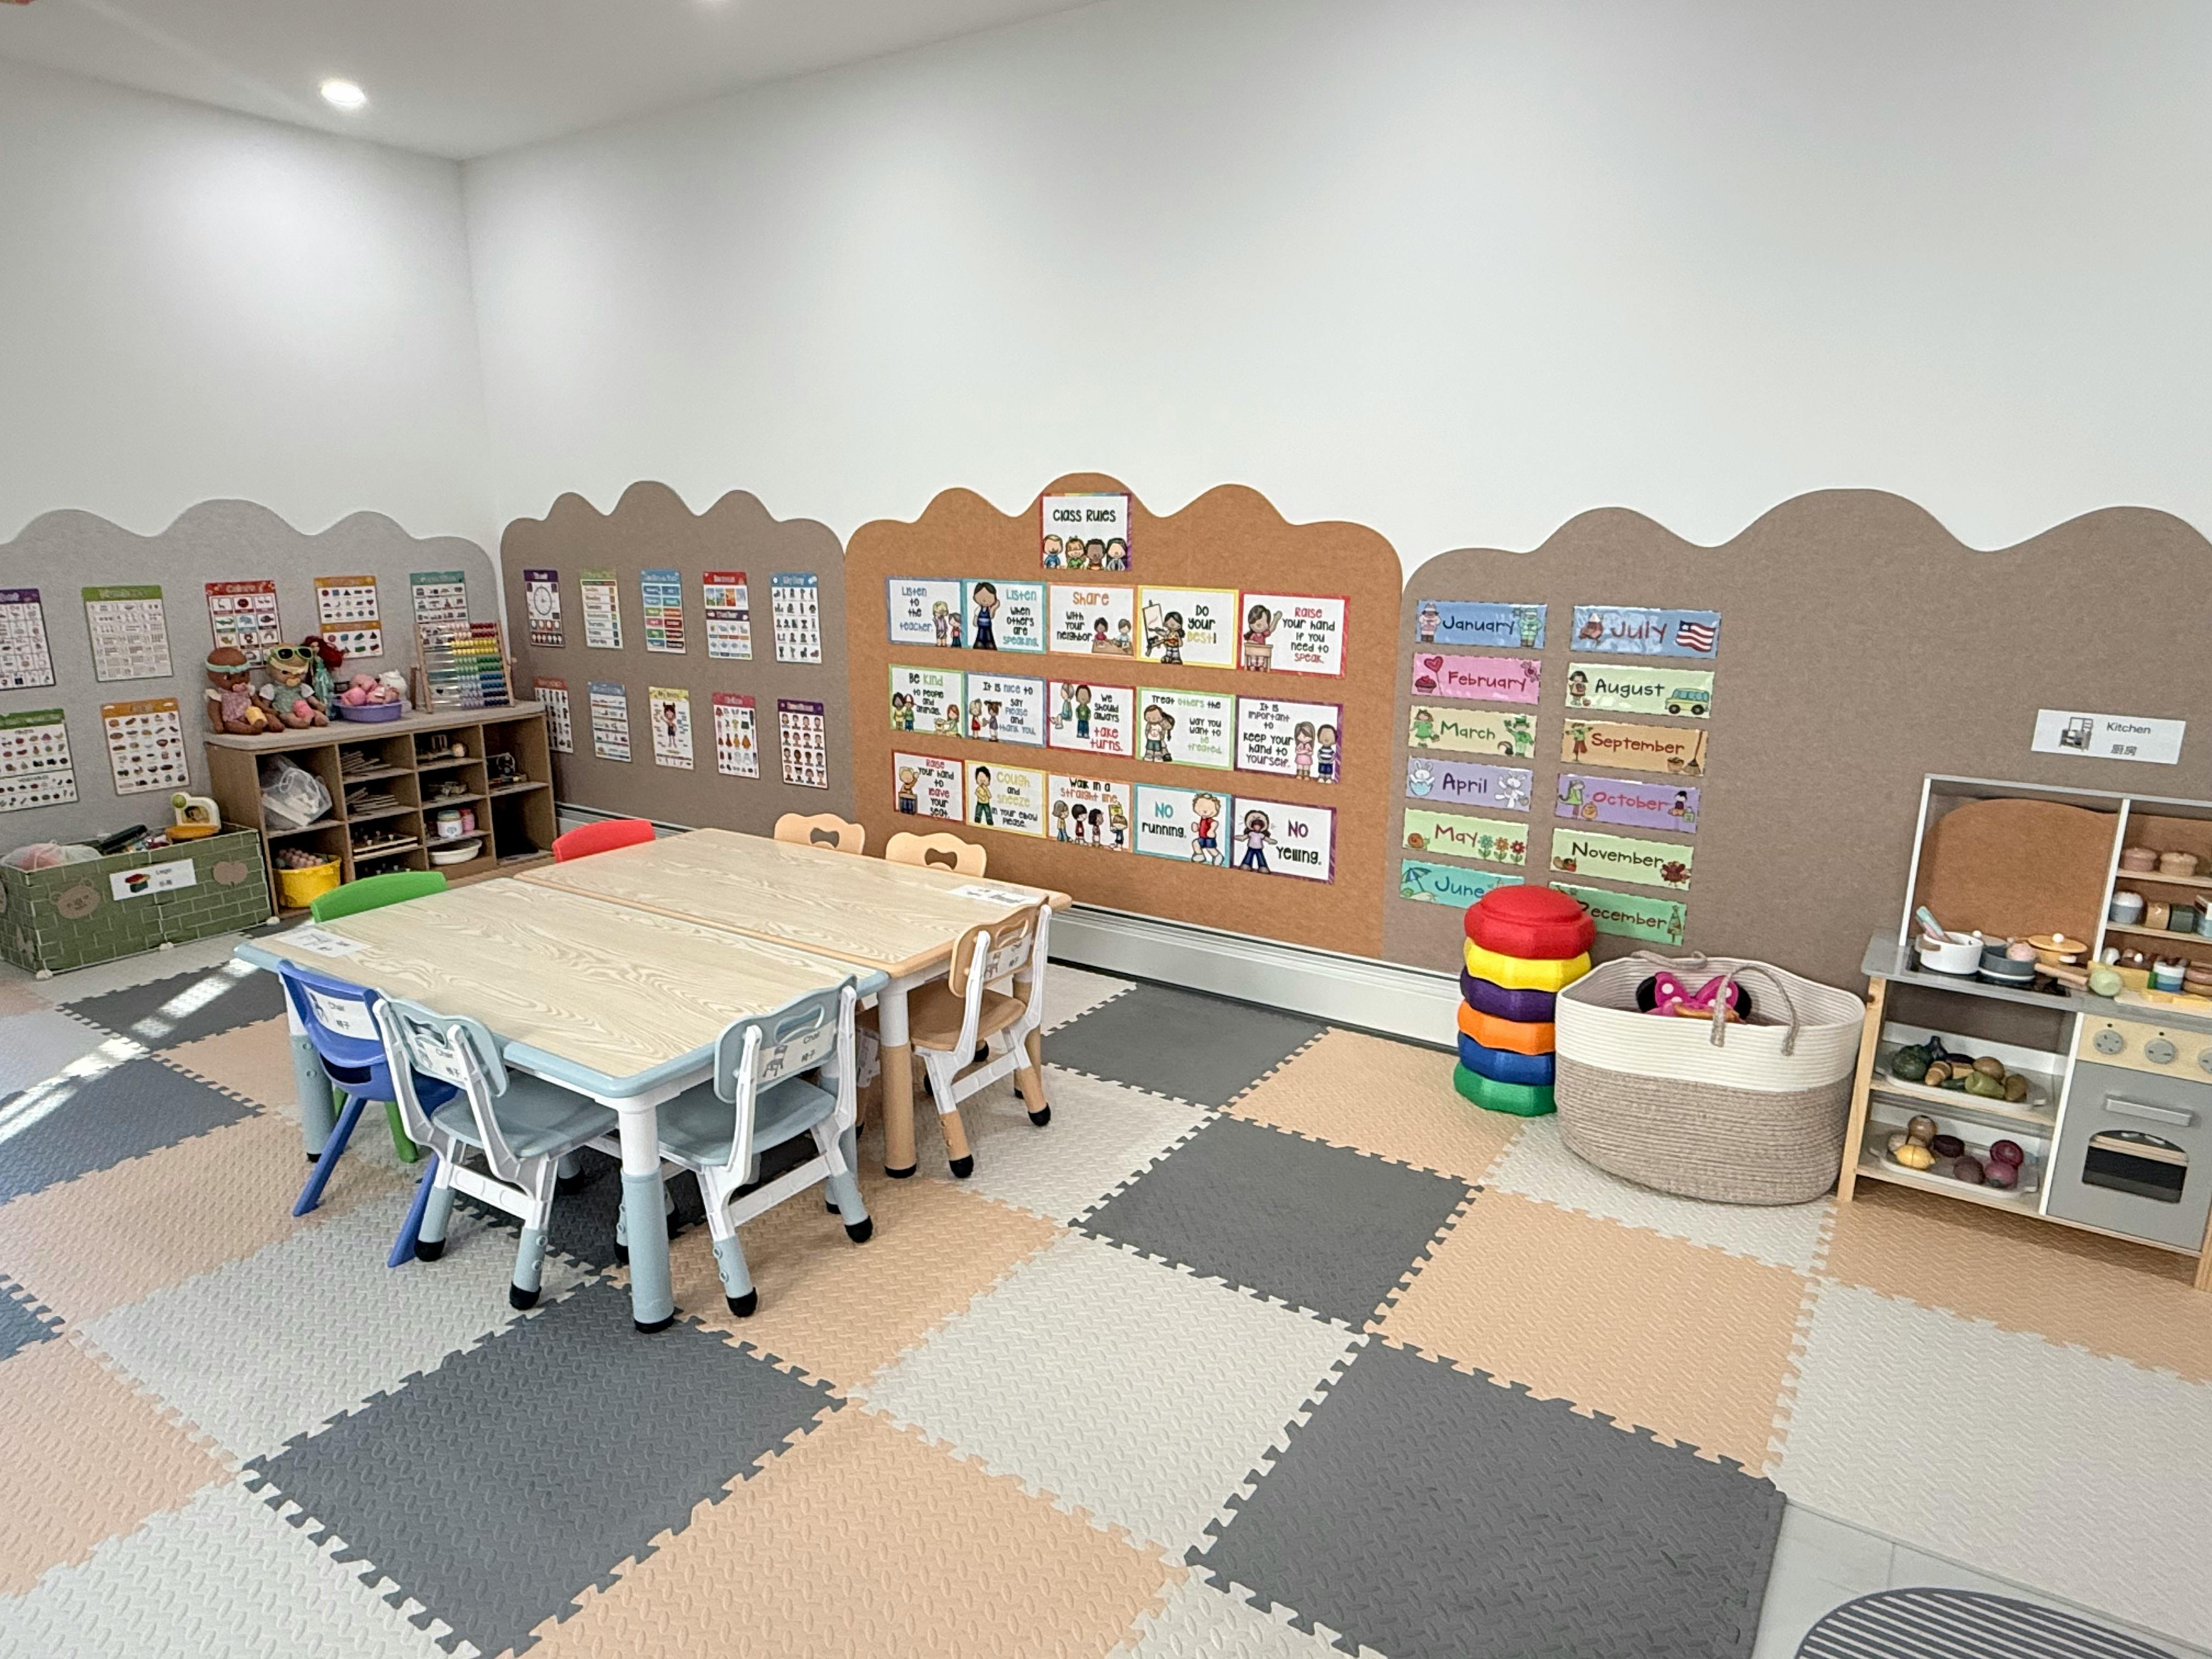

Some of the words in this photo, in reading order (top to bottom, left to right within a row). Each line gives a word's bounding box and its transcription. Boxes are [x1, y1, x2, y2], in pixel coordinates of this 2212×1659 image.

[1053, 509, 1081, 522] Class
[1086, 509, 1116, 523] Rules
[902, 586, 927, 597] Listen
[1006, 588, 1037, 601] Listen
[910, 598, 919, 607] to
[1073, 591, 1109, 606] Share
[908, 608, 922, 617] the
[1010, 606, 1030, 616] when
[1295, 607, 1323, 618] Raise
[1006, 617, 1034, 627] others
[1188, 618, 1216, 630] your
[1310, 620, 1335, 631] hand
[1443, 616, 1515, 635] January
[1013, 627, 1028, 636] are
[1296, 632, 1302, 641] if
[1610, 621, 1668, 644] July
[1291, 642, 1314, 652] need
[1318, 644, 1329, 653] to
[909, 673, 920, 684] Be
[1448, 670, 1527, 692] February
[983, 682, 991, 691] It
[995, 684, 1001, 692] is
[1003, 684, 1020, 693] nice
[1024, 686, 1034, 695] to
[1595, 678, 1664, 698] August
[1011, 698, 1023, 707] say
[1094, 702, 1119, 713] should
[1152, 695, 1175, 705] Treat
[1207, 701, 1221, 709] the
[1011, 716, 1023, 725] and
[1094, 713, 1119, 723] always
[1189, 718, 1205, 726] way
[1248, 711, 1290, 722] important
[1094, 726, 1119, 739] take
[1189, 726, 1209, 735] want
[1440, 720, 1496, 740] March
[2107, 721, 2151, 734] Kitchen
[1090, 739, 1124, 751] turns.
[1249, 743, 1272, 754] hand
[1276, 747, 1288, 755] to
[1592, 733, 1685, 754] September
[927, 759, 945, 769] Raise
[937, 771, 954, 780] hand
[997, 772, 1030, 787] Cough
[934, 778, 944, 787] to
[1069, 777, 1089, 789] Walk
[1093, 781, 1101, 791] in
[1105, 783, 1110, 792] a
[1443, 772, 1487, 795] April
[929, 788, 950, 798] leave
[1007, 787, 1020, 795] and
[1060, 787, 1098, 801] straight
[997, 794, 1030, 807] sneeze
[1593, 792, 1668, 811] October
[930, 807, 950, 819] seat.
[1019, 811, 1037, 821] elbow
[1142, 822, 1187, 838] running.
[1435, 824, 1478, 848] May
[1572, 842, 1664, 868] November
[1435, 876, 1485, 898] June
